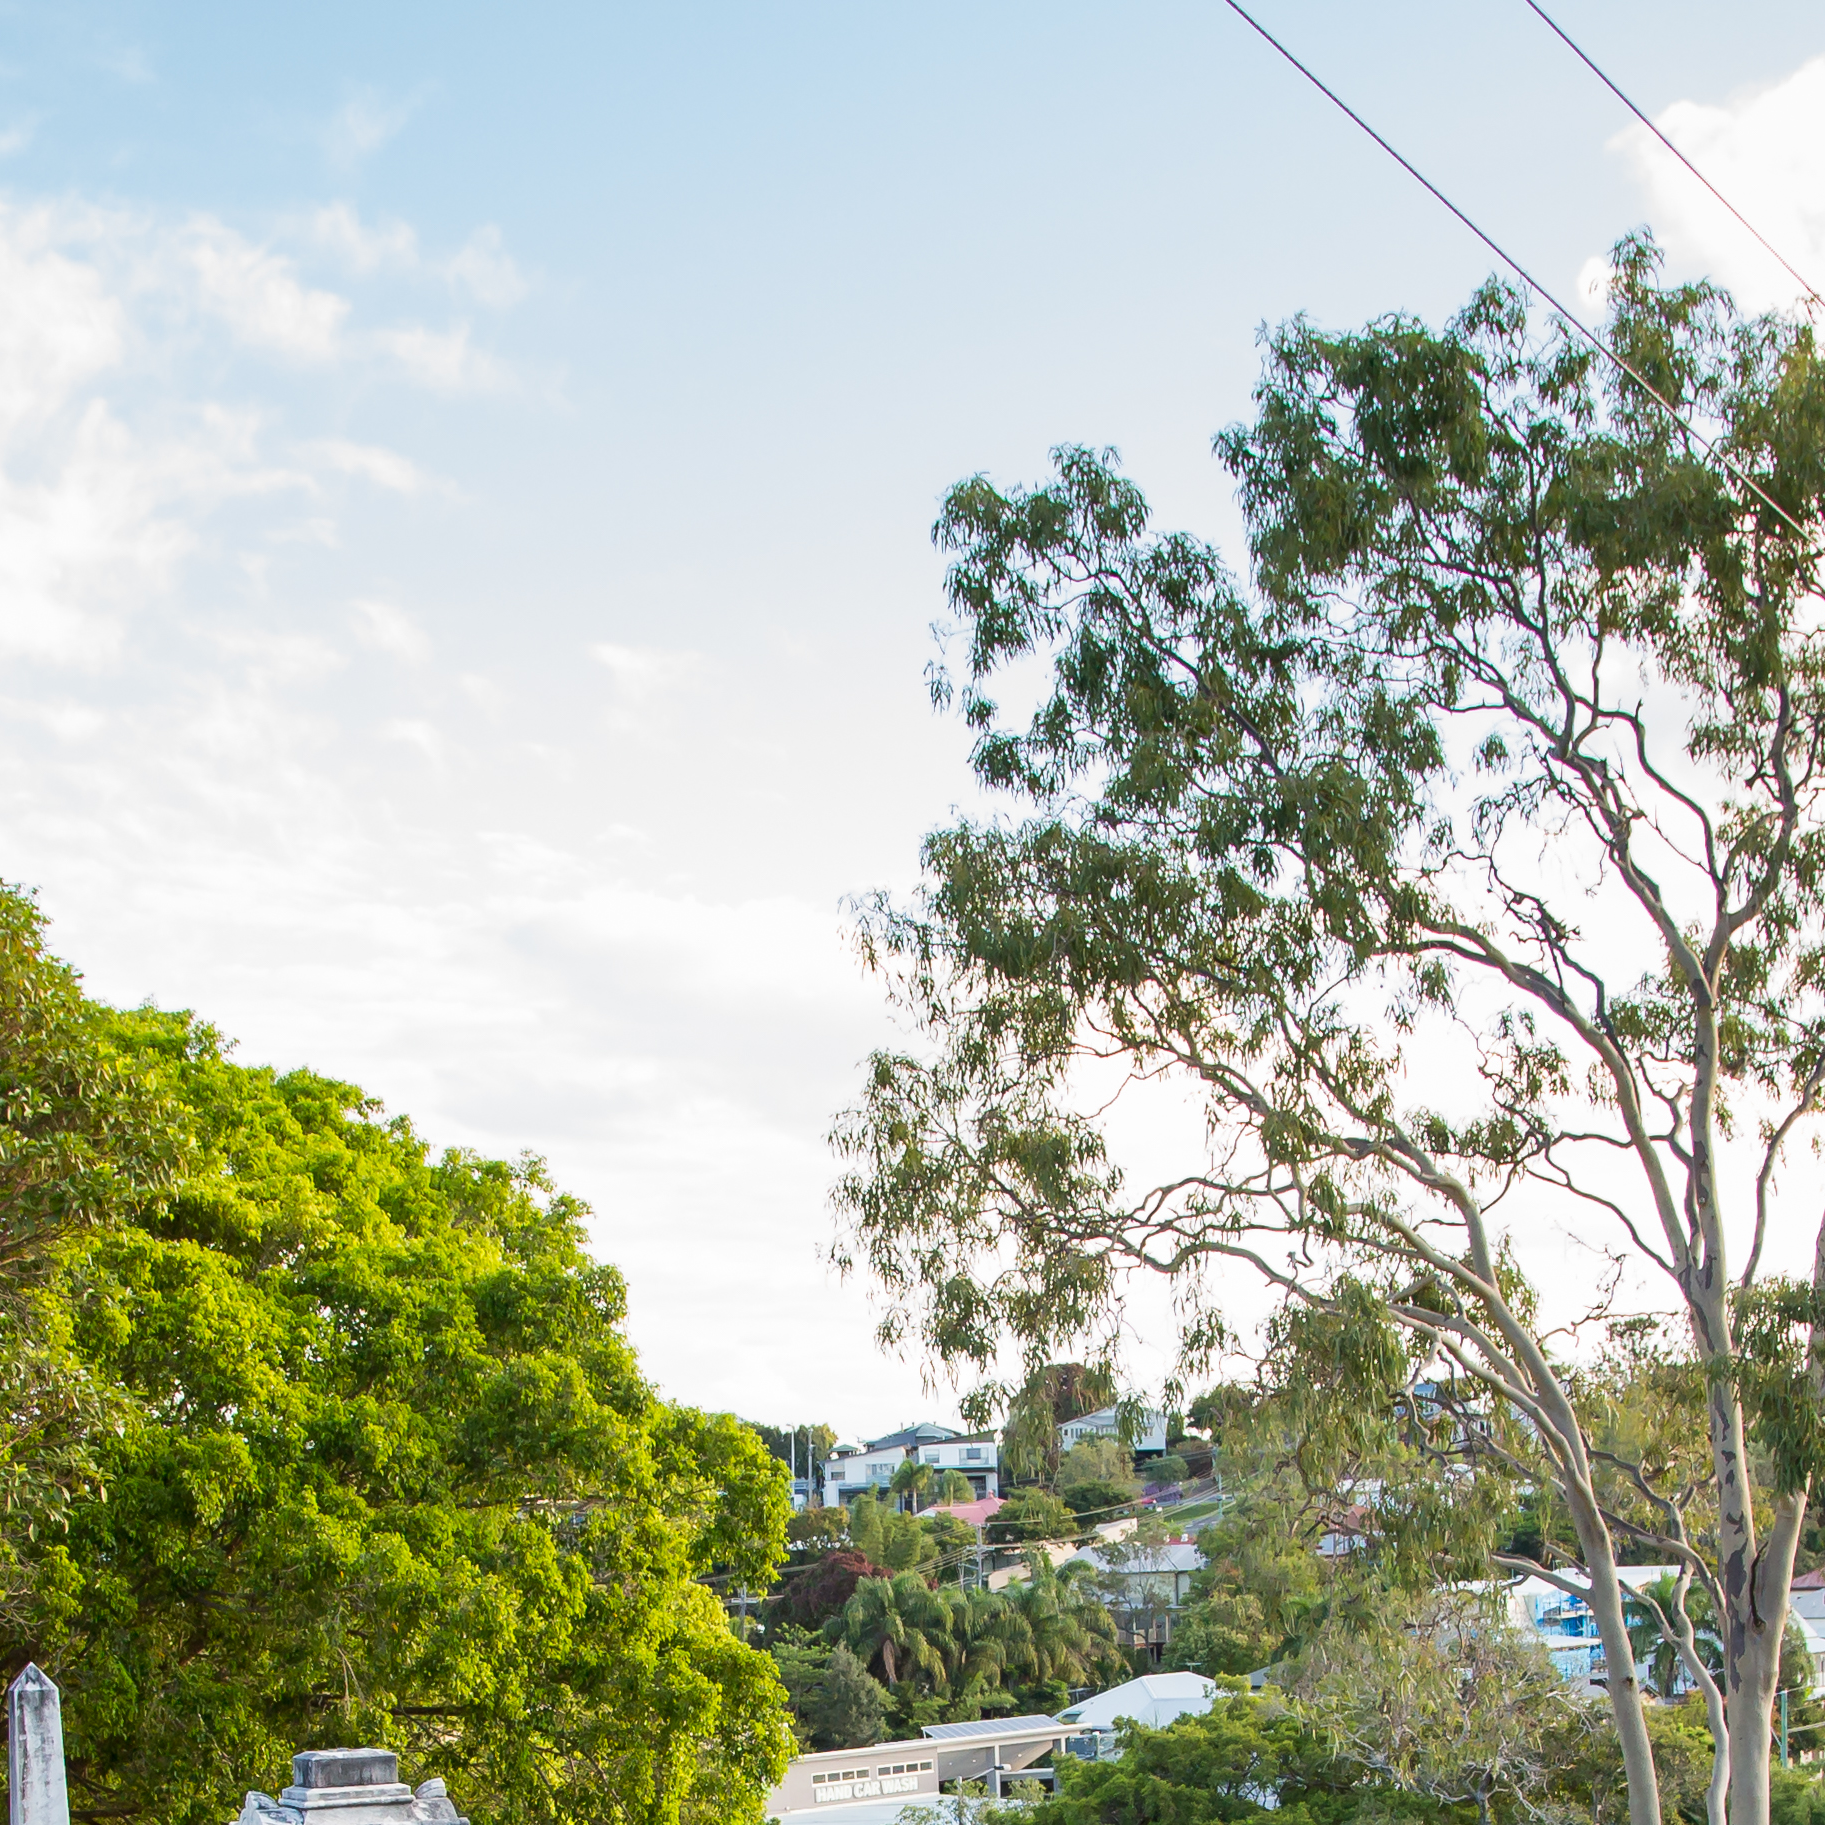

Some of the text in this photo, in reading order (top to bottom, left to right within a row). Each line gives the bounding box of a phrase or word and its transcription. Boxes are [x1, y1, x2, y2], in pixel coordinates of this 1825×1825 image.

[815, 1775, 918, 1803] HAND CAR WASH
